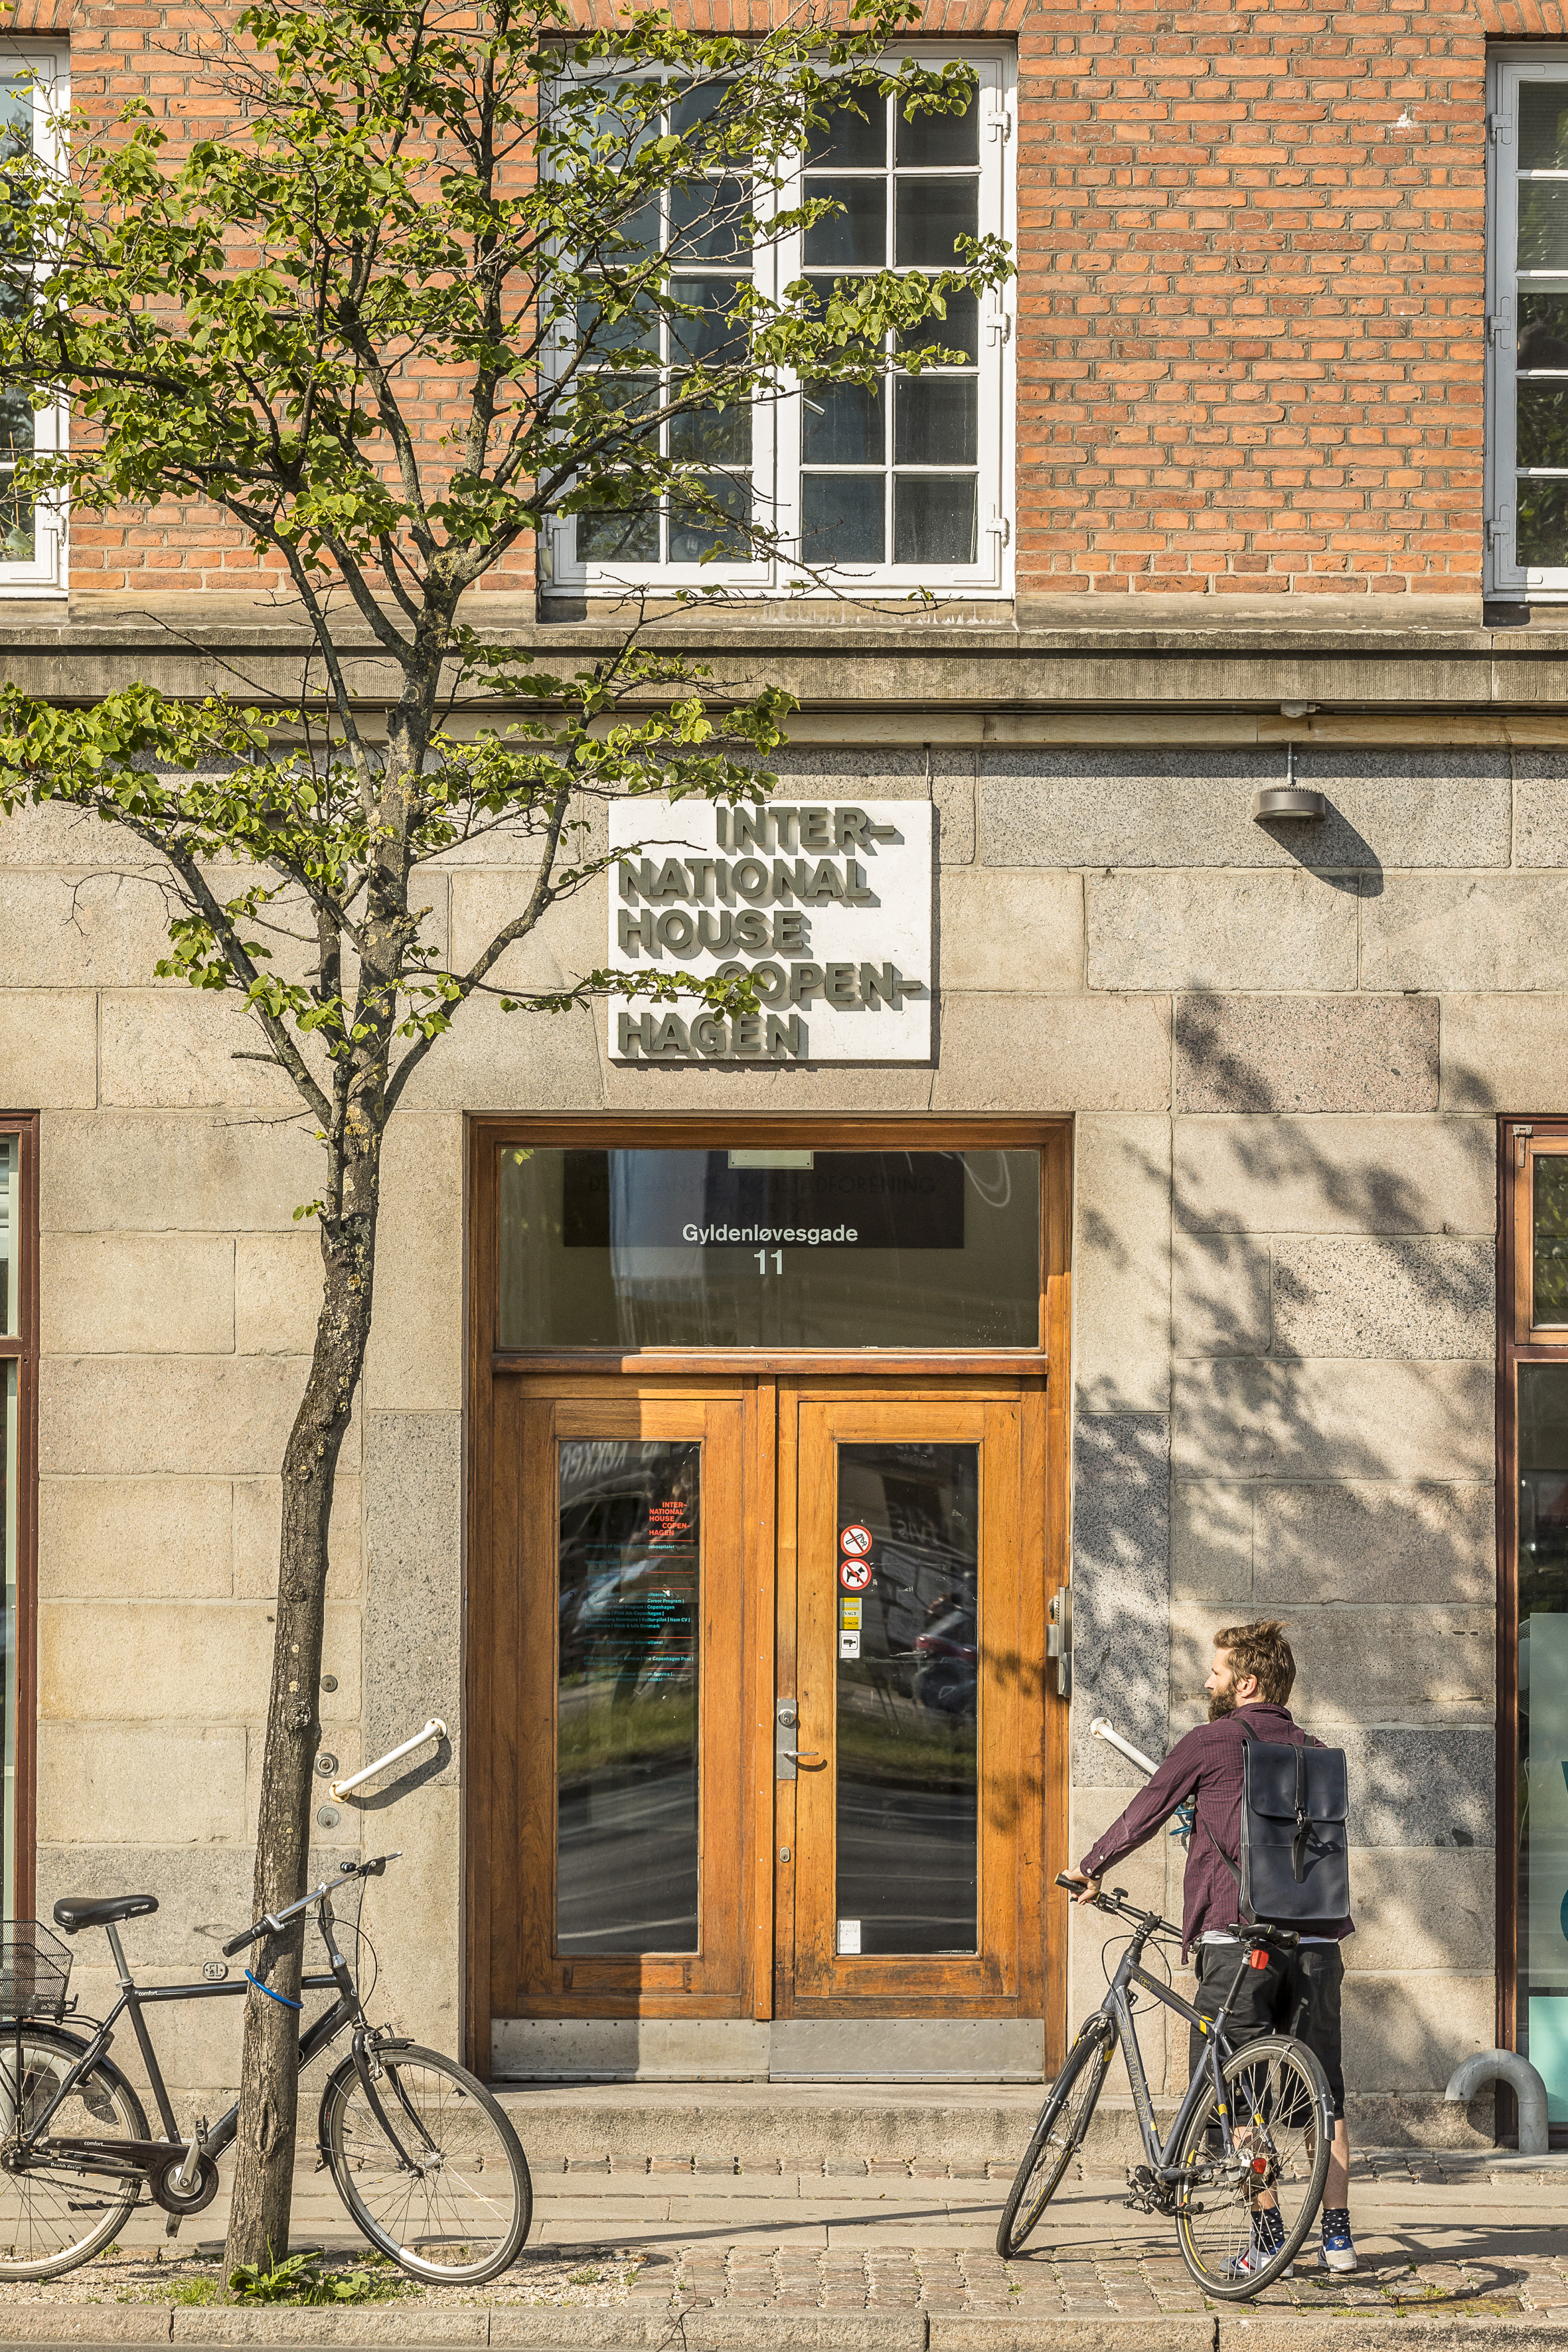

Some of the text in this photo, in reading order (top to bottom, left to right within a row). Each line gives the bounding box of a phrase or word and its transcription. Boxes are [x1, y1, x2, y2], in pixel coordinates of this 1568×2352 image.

[716, 807, 894, 846] INTER-
[618, 857, 871, 898] NATIONAL
[617, 909, 803, 949] HOUSE
[617, 1012, 799, 1052] HAGEN
[682, 1223, 858, 1245] Gyldenløvesgade
[754, 1249, 783, 1275] 11
[1117, 2012, 1149, 2123] CENTURION
